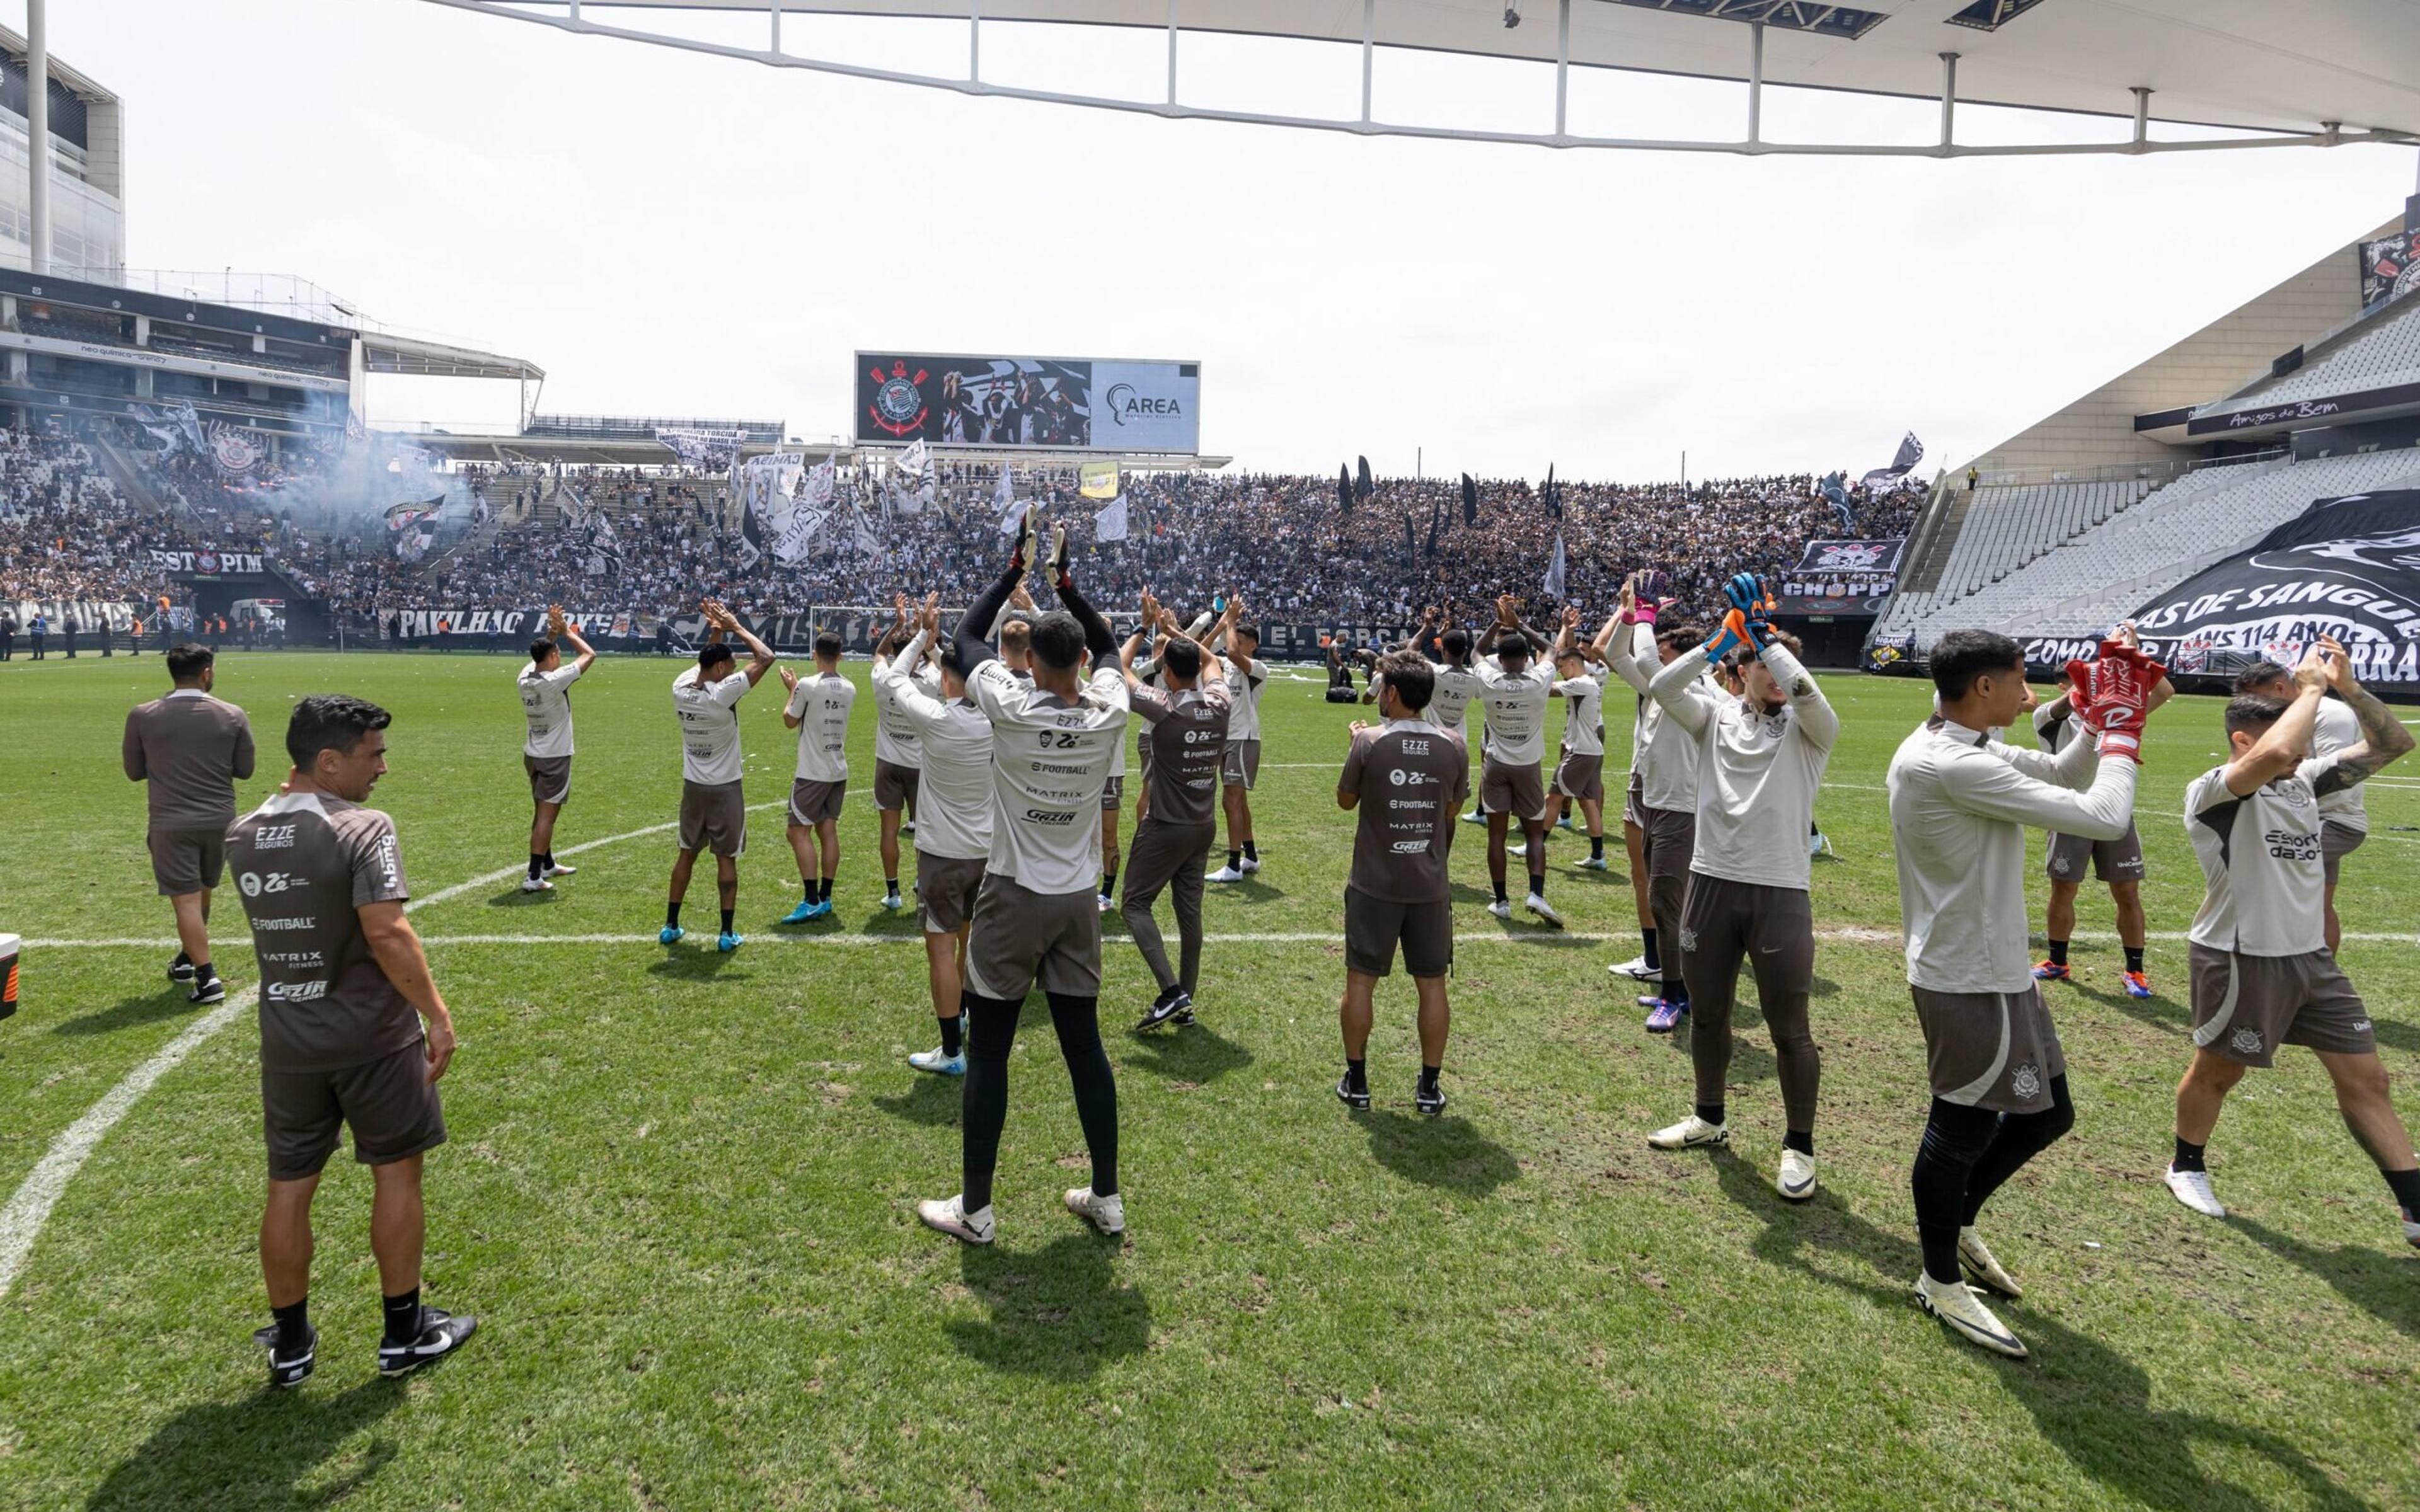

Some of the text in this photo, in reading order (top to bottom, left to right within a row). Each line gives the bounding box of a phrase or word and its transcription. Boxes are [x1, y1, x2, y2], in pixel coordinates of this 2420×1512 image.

[1126, 398, 1180, 414] AREA
[2230, 401, 2339, 427] Amigos do Bem
[2184, 588, 2245, 624] DE
[2241, 622, 2279, 641] 114
[2024, 638, 2097, 665] COMO
[1402, 739, 1429, 750] EZZE
[1026, 786, 1083, 798] MATRIX
[255, 824, 296, 842] EZZE
[254, 839, 294, 850] SEGUROS
